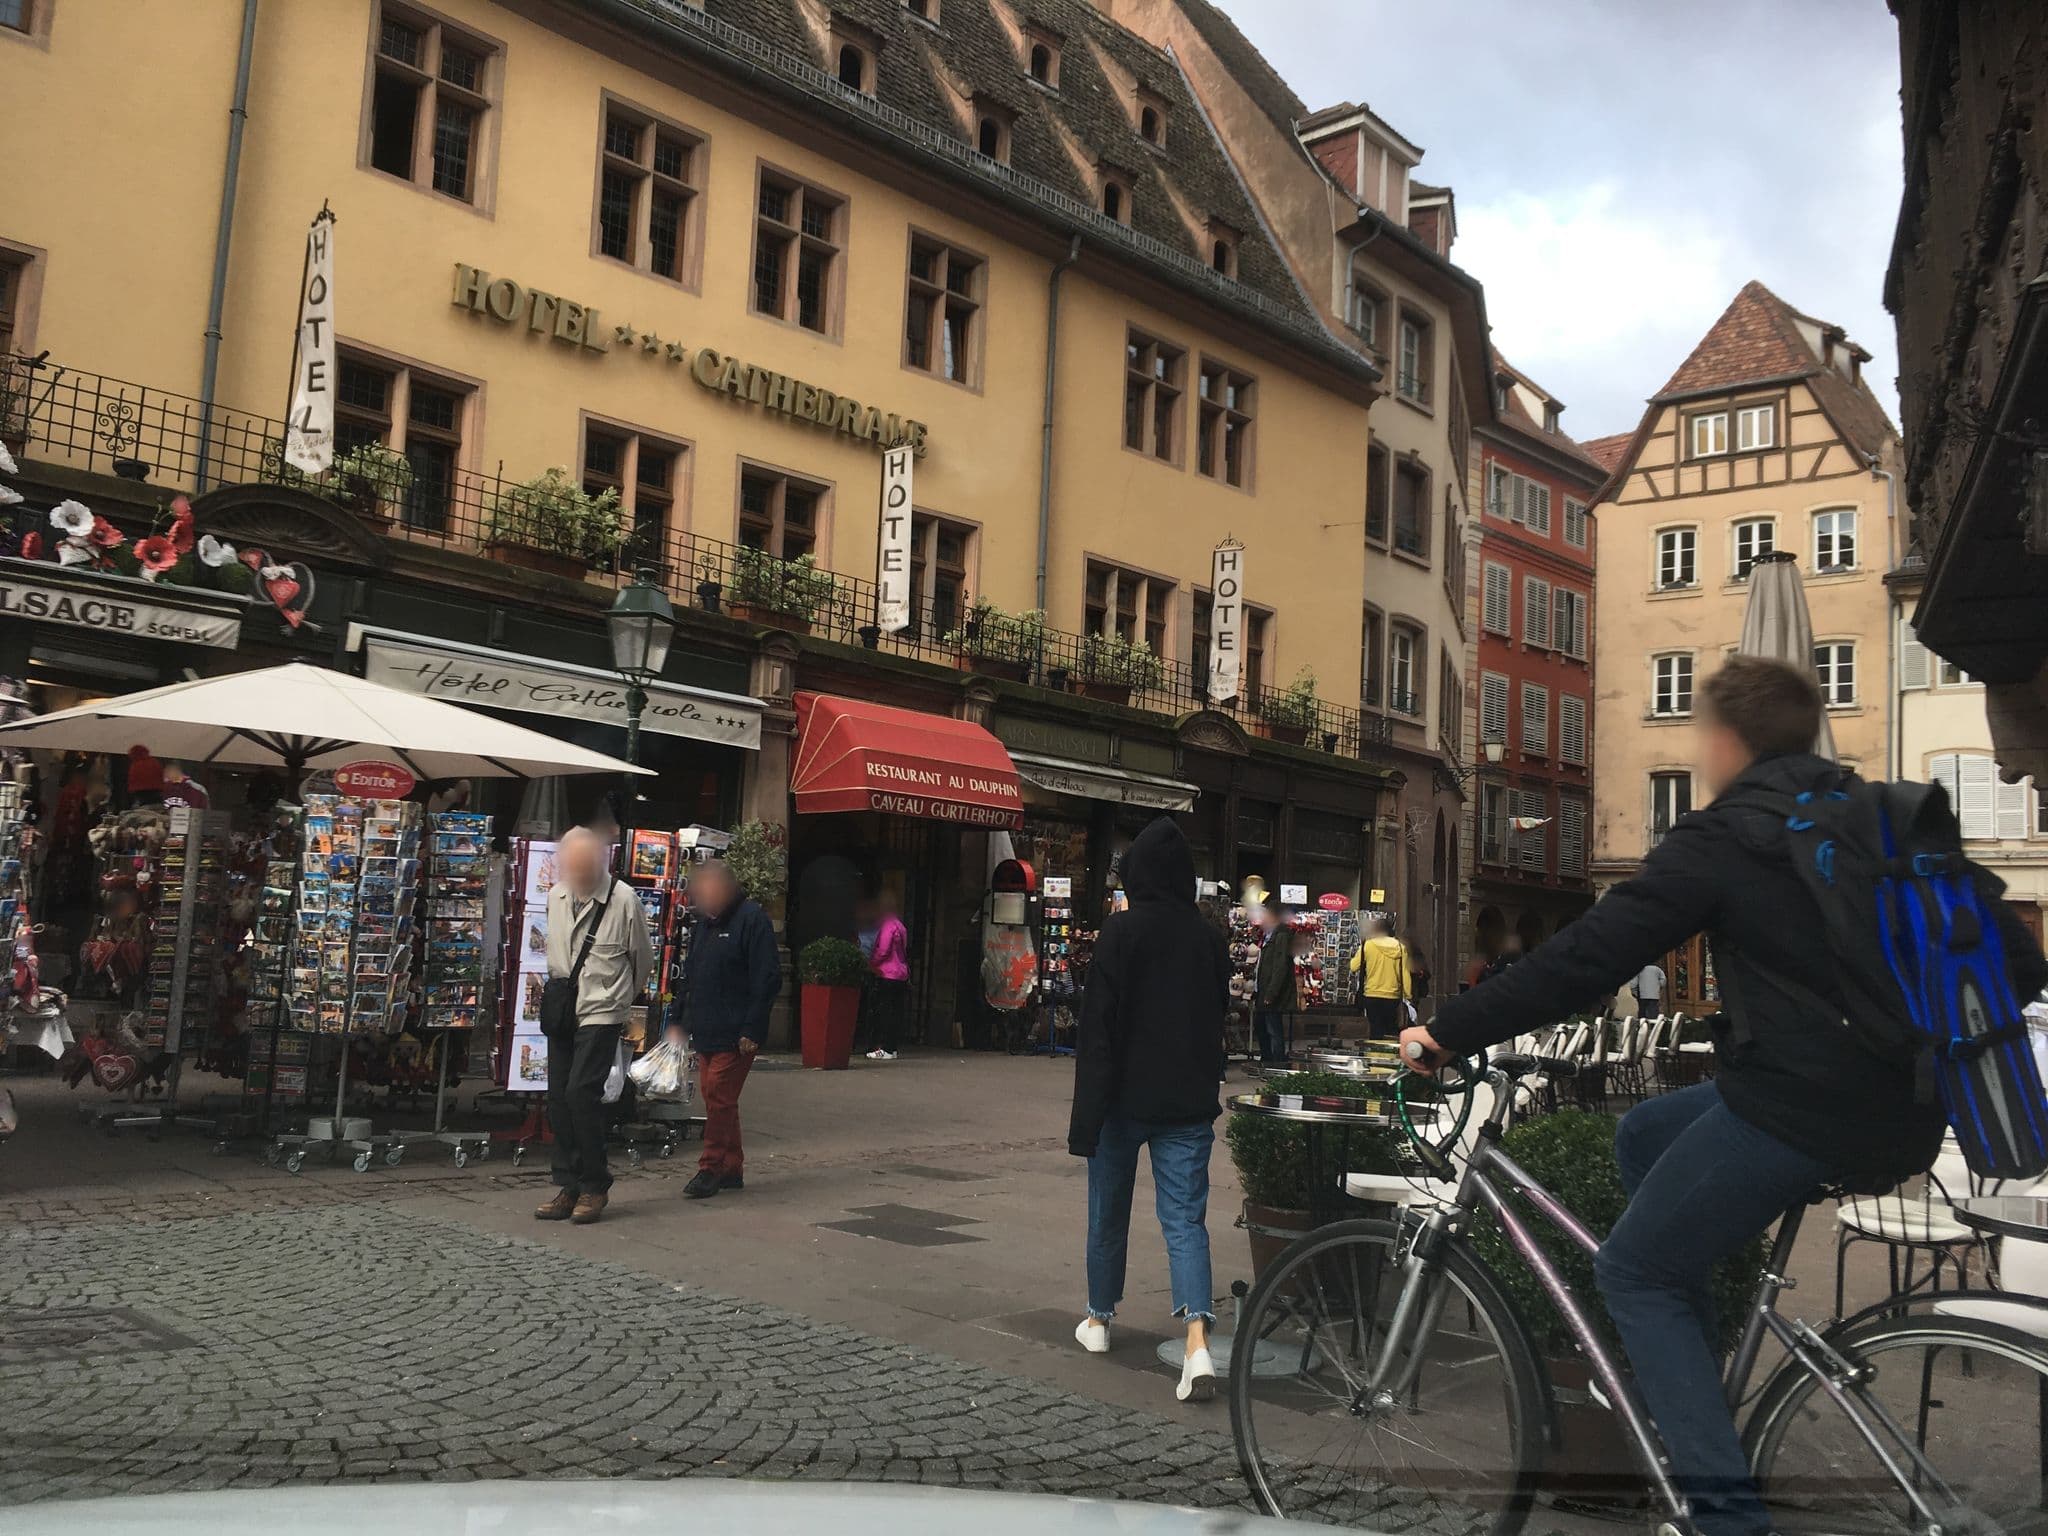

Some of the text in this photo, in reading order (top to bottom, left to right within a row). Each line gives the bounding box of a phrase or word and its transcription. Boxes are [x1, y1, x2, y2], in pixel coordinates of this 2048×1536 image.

[302, 230, 327, 433] HOTEL
[453, 262, 928, 457] HOTEL CATHEDRALE
[883, 452, 906, 603] HOTEL
[1217, 552, 1237, 676] HOTEL
[866, 762, 1018, 798] RESTAURANT AU DAUPHIN
[870, 794, 1020, 827] CAVEAU GURTLERHOFT
